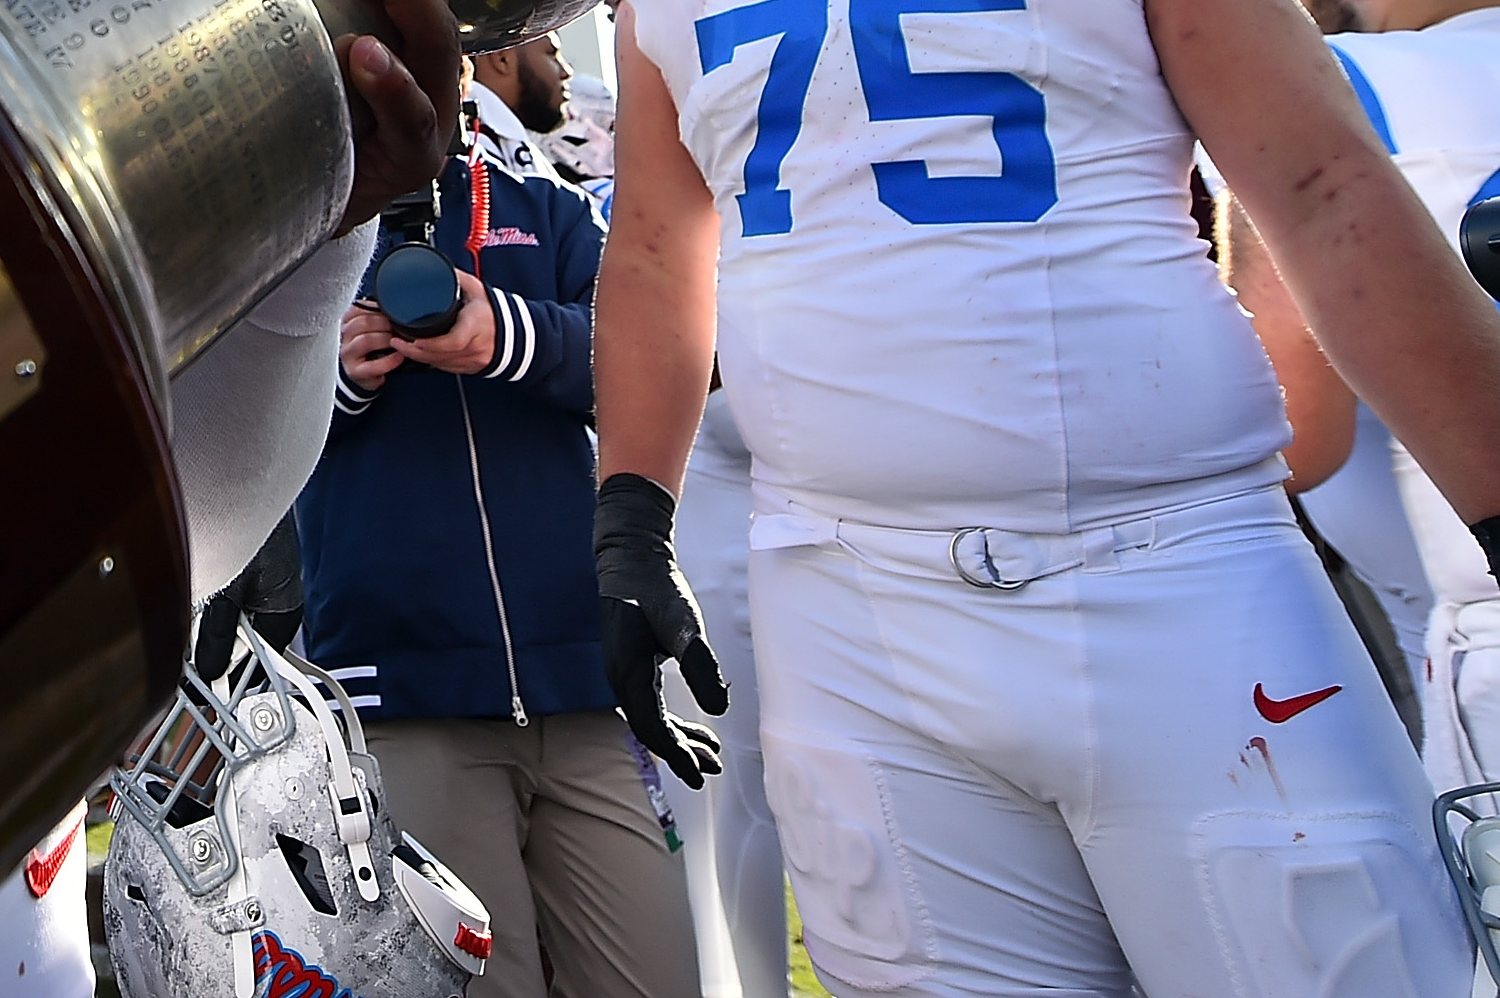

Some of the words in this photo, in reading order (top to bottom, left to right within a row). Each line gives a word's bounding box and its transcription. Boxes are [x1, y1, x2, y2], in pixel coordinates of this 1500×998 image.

[156, 32, 200, 89] 1988
[177, 21, 220, 76] 1987
[113, 58, 159, 116] 1990
[497, 227, 538, 246] Miss
